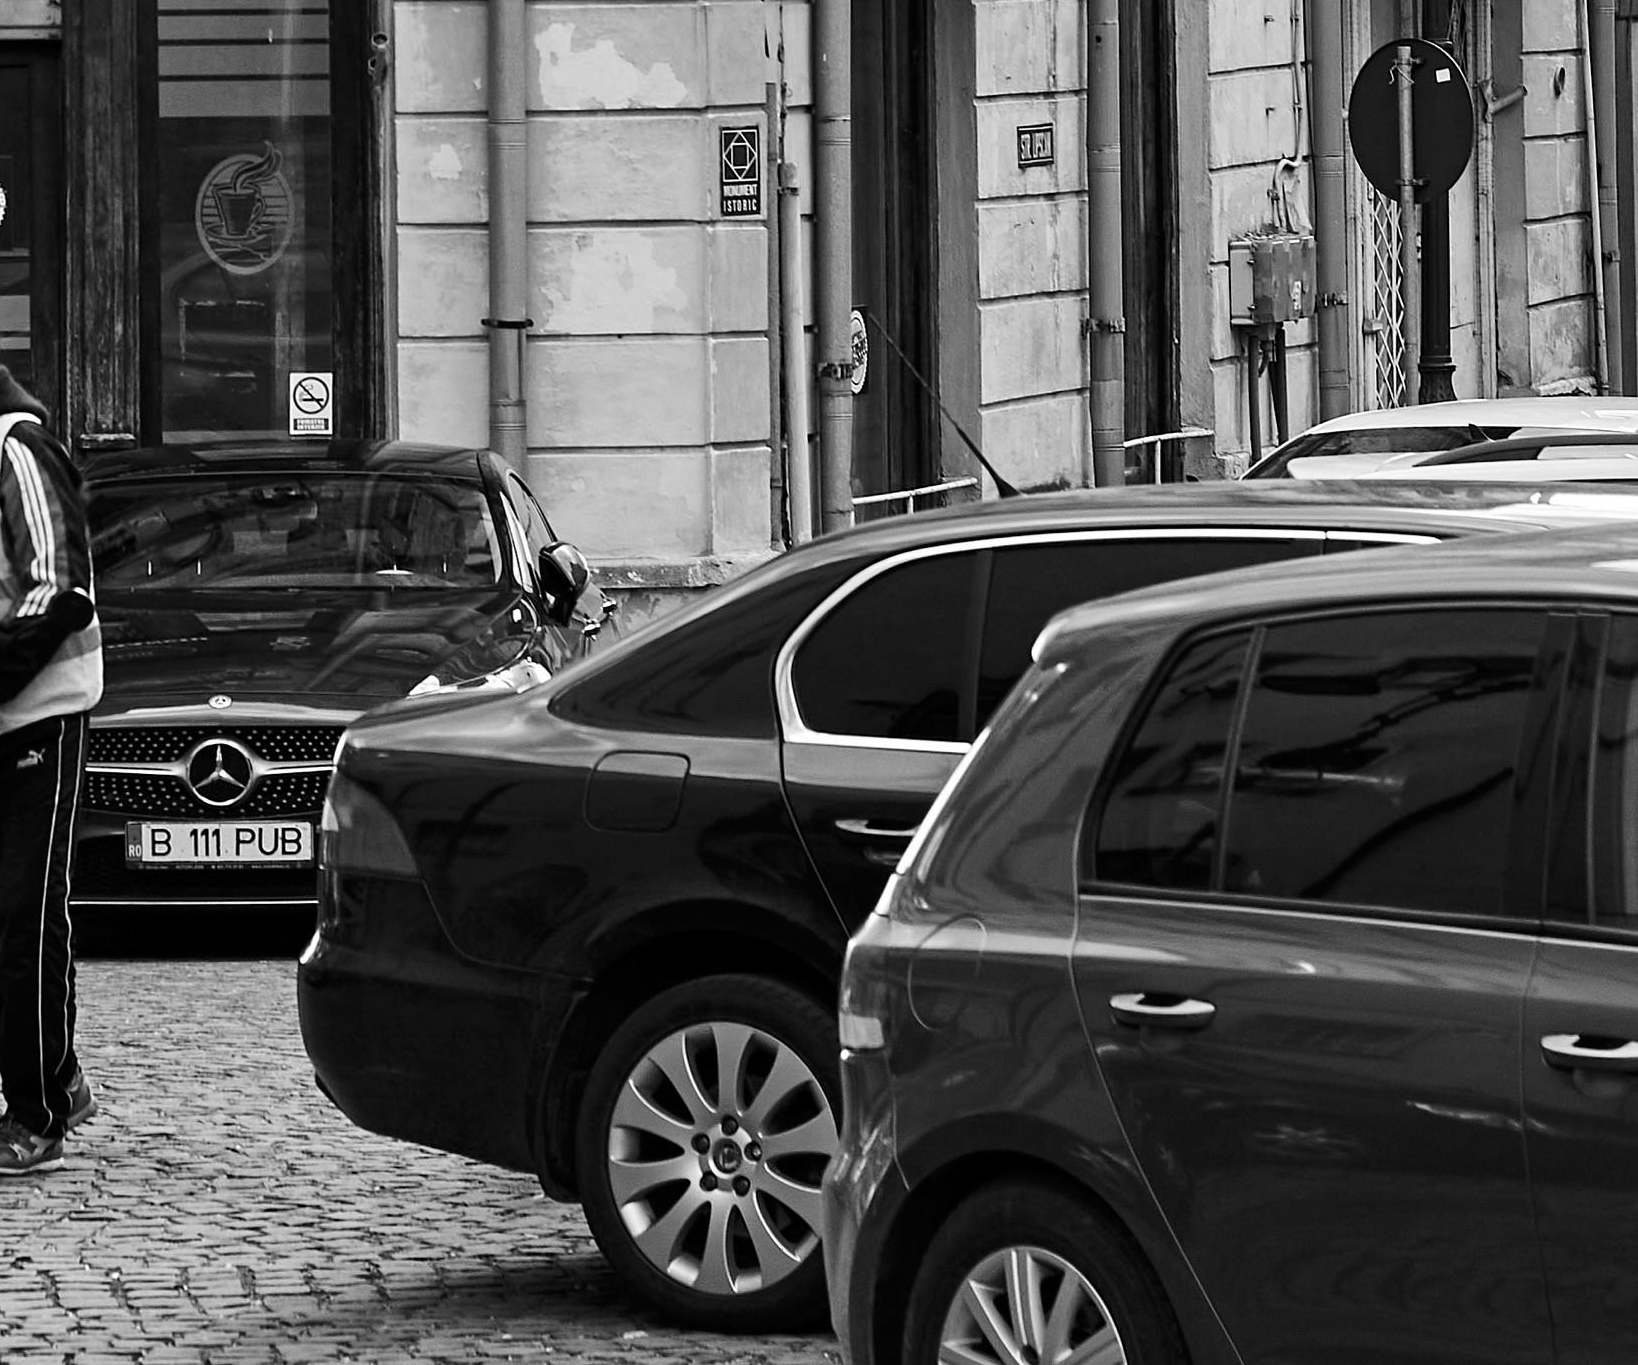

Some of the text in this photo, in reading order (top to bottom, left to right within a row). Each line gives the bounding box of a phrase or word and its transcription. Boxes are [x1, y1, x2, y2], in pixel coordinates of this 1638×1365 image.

[723, 199, 758, 212] ISTORIC
[128, 827, 303, 858] RO B 111 PUB
